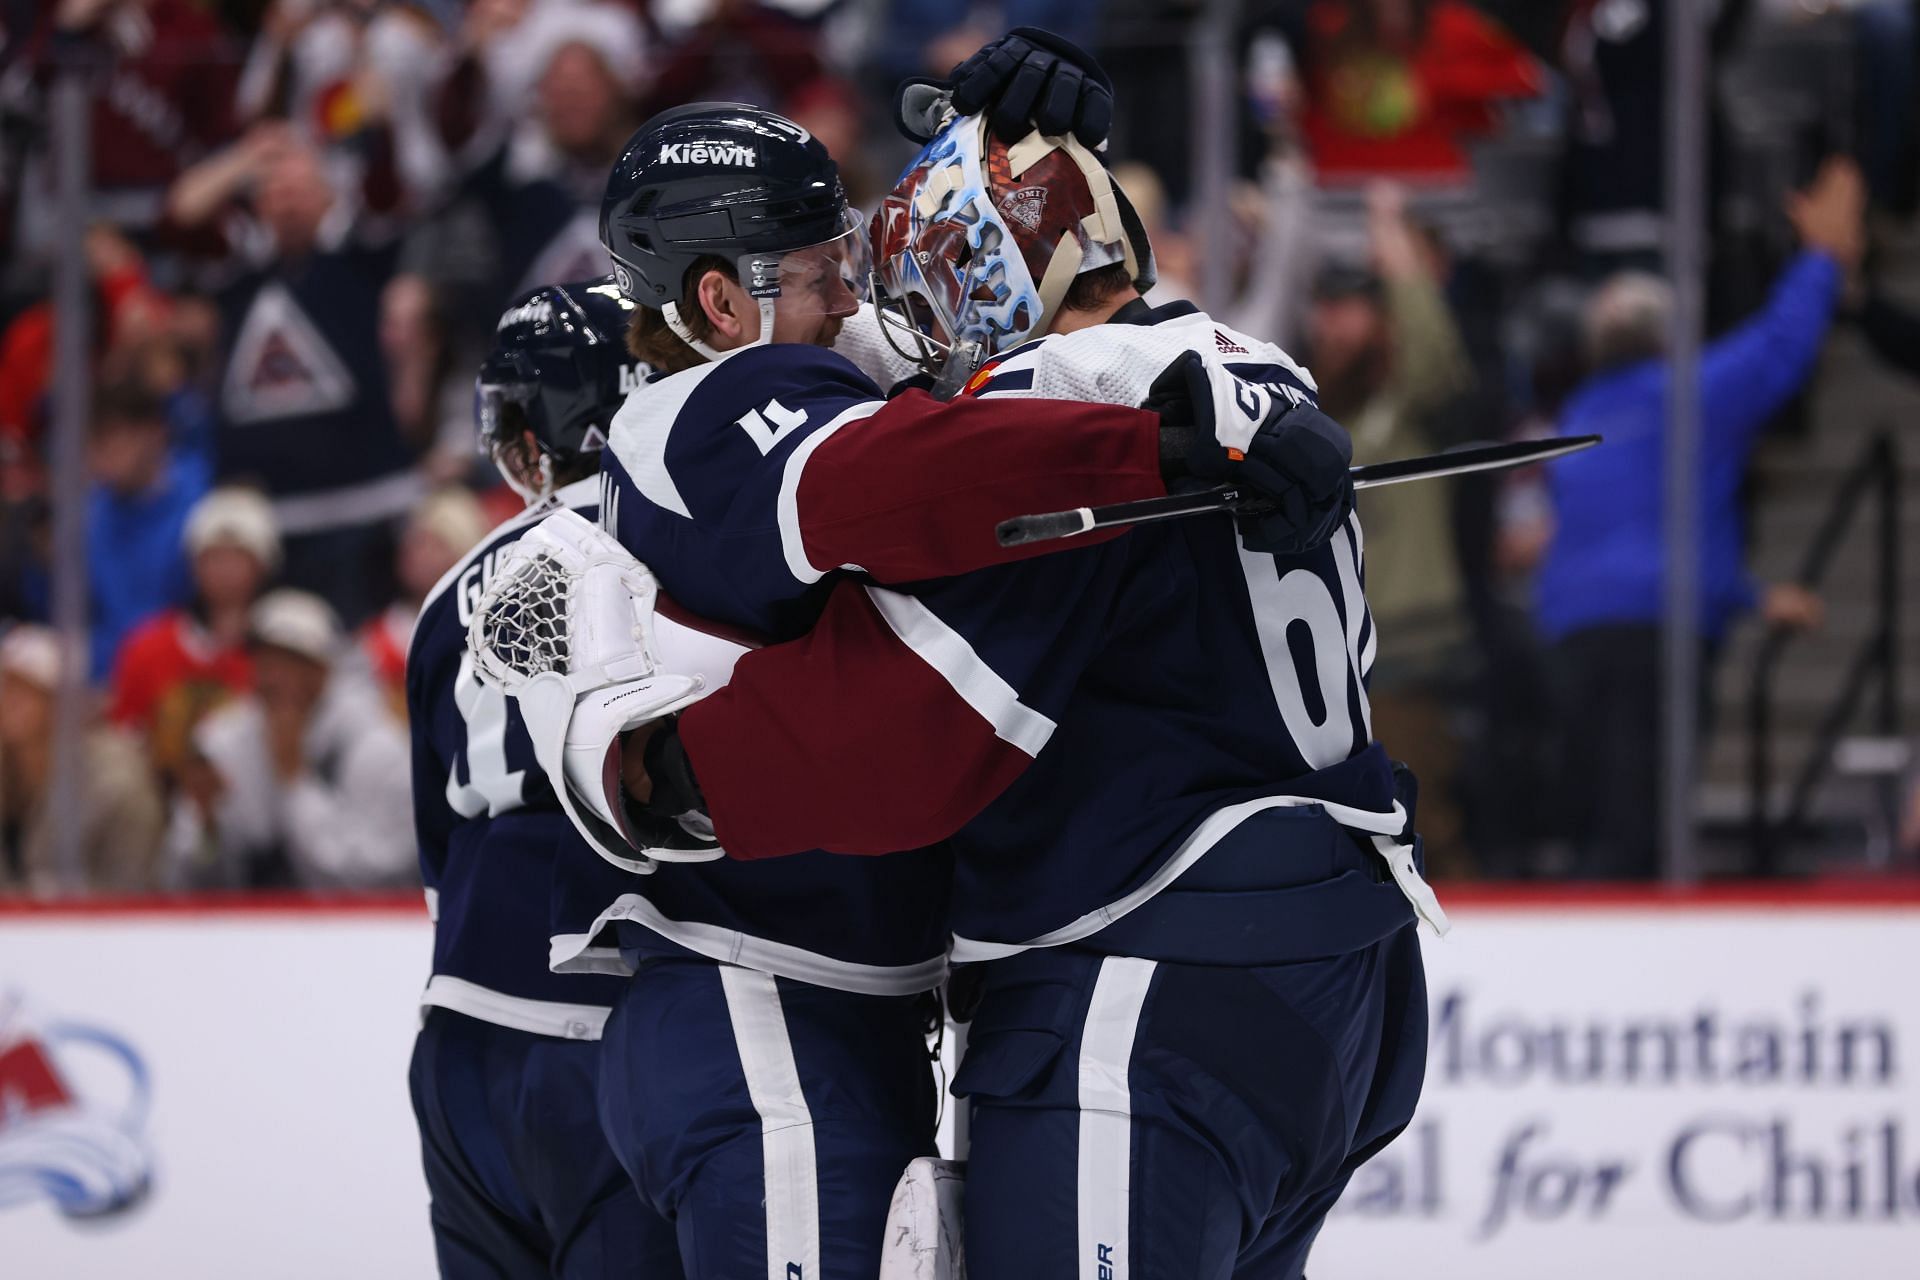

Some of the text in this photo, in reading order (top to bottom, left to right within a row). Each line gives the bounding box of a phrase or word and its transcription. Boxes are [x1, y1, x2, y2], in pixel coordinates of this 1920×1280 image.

[659, 143, 756, 168] Kiewit
[1004, 190, 1041, 209] SOMI
[734, 398, 809, 457] 4
[1472, 1120, 1632, 1246] for
[1666, 1114, 1920, 1222] Chil
